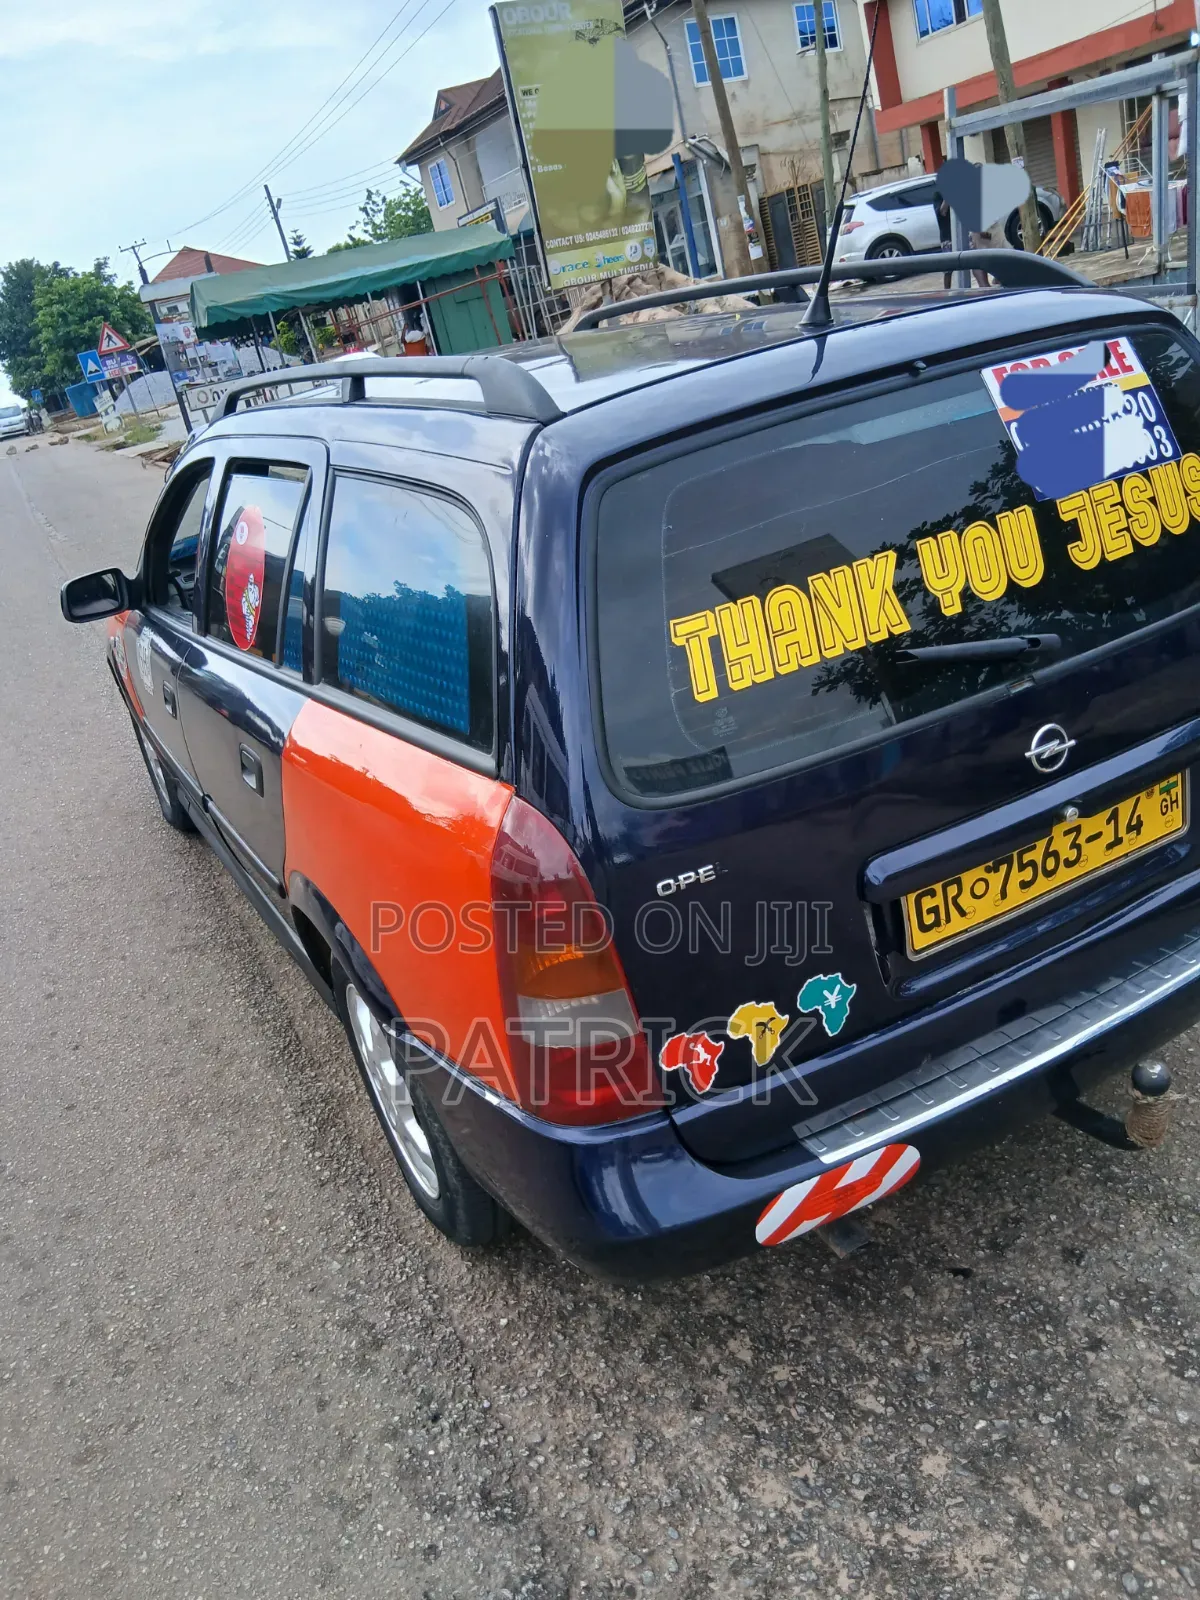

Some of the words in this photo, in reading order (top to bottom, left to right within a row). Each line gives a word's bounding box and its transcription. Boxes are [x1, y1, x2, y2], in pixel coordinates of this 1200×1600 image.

[503, 2, 571, 25] OBOUR
[521, 89, 533, 97] WE
[545, 235, 573, 249] CONTACT
[549, 259, 589, 275] race
[563, 273, 598, 286] OBOUR
[670, 549, 911, 703] THANK
[915, 504, 1045, 617] YOU
[1056, 452, 1200, 571] JESUS
[1159, 791, 1180, 817] GH
[914, 876, 968, 934] GR
[991, 796, 1144, 901] 7563-14
